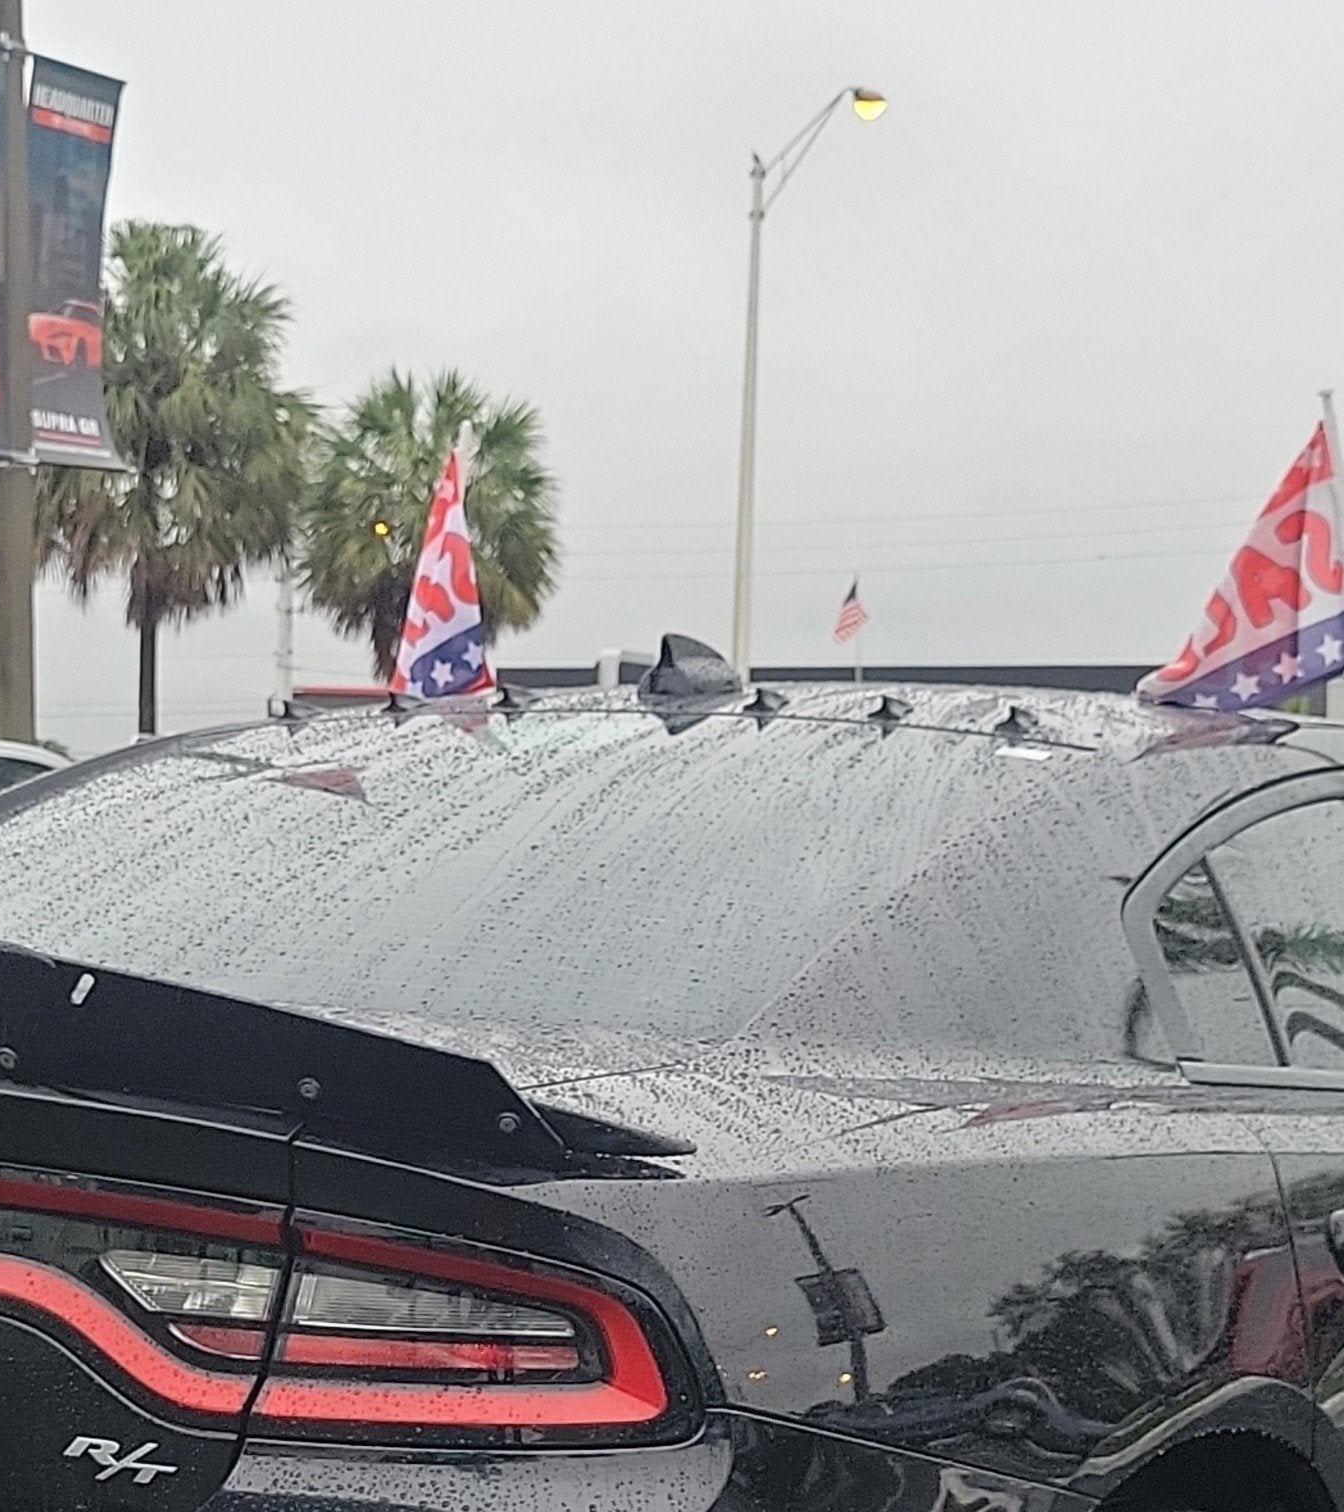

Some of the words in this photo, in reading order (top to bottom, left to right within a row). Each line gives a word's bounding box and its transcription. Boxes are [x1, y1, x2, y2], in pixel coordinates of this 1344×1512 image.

[33, 83, 115, 128] HEADQUARTER
[30, 408, 78, 434] SUPRA
[62, 1435, 179, 1484] R/T
